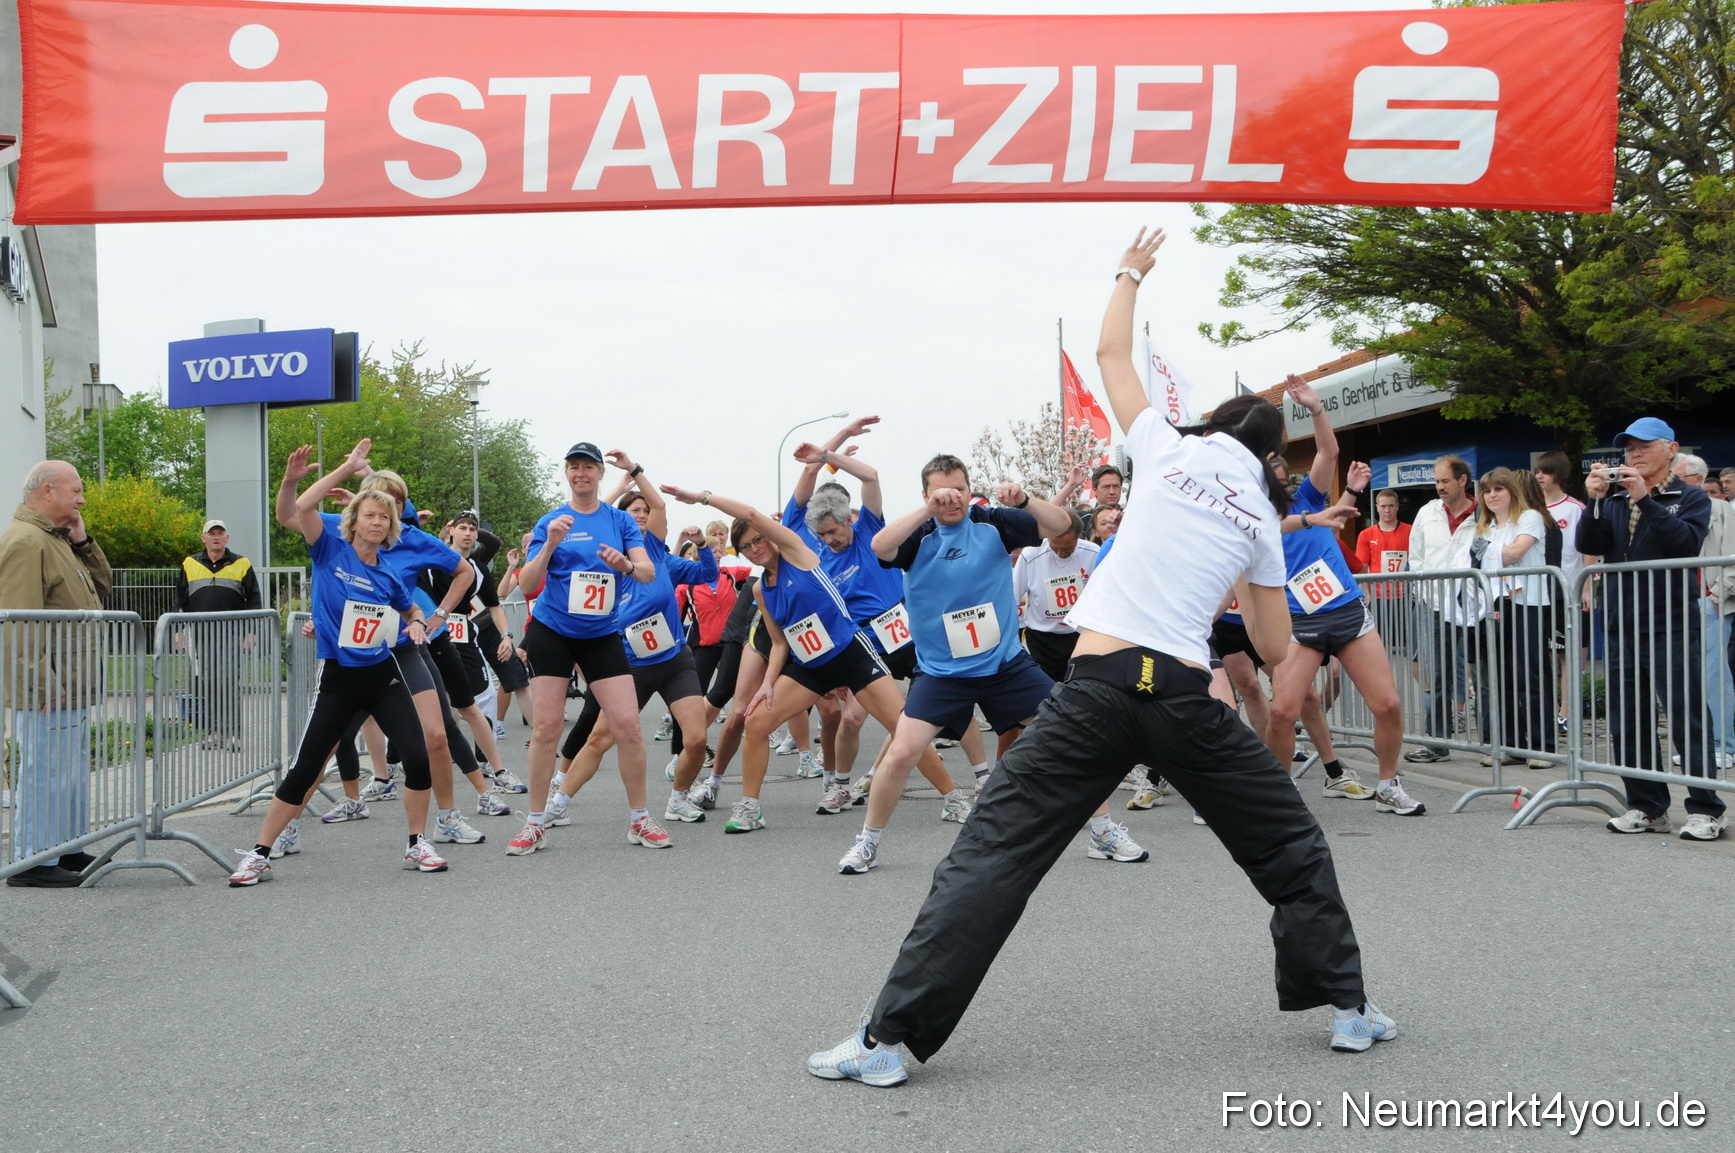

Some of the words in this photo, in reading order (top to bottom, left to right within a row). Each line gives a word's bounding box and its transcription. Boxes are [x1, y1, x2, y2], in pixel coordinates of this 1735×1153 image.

[183, 351, 308, 383] VOLVO
[1342, 378, 1388, 407] Gerhart
[1391, 372, 1403, 393] &
[1163, 466, 1262, 540] ZEITLOS
[1388, 559, 1402, 572] 57
[1050, 576, 1068, 584] MEYER
[1293, 569, 1312, 584] MEYER
[583, 585, 606, 610] 21
[1055, 585, 1078, 608] 86
[1303, 575, 1334, 605] 66
[353, 604, 377, 612] MEYER
[876, 612, 894, 624] MEYER
[952, 610, 975, 620] MEYER
[352, 618, 380, 644] 67
[447, 622, 464, 640] 28
[631, 621, 649, 632] MEYER
[788, 622, 804, 634] MEYER
[884, 618, 910, 645] 73
[965, 621, 980, 649] 1
[643, 631, 658, 650] 8
[797, 630, 822, 655] 10
